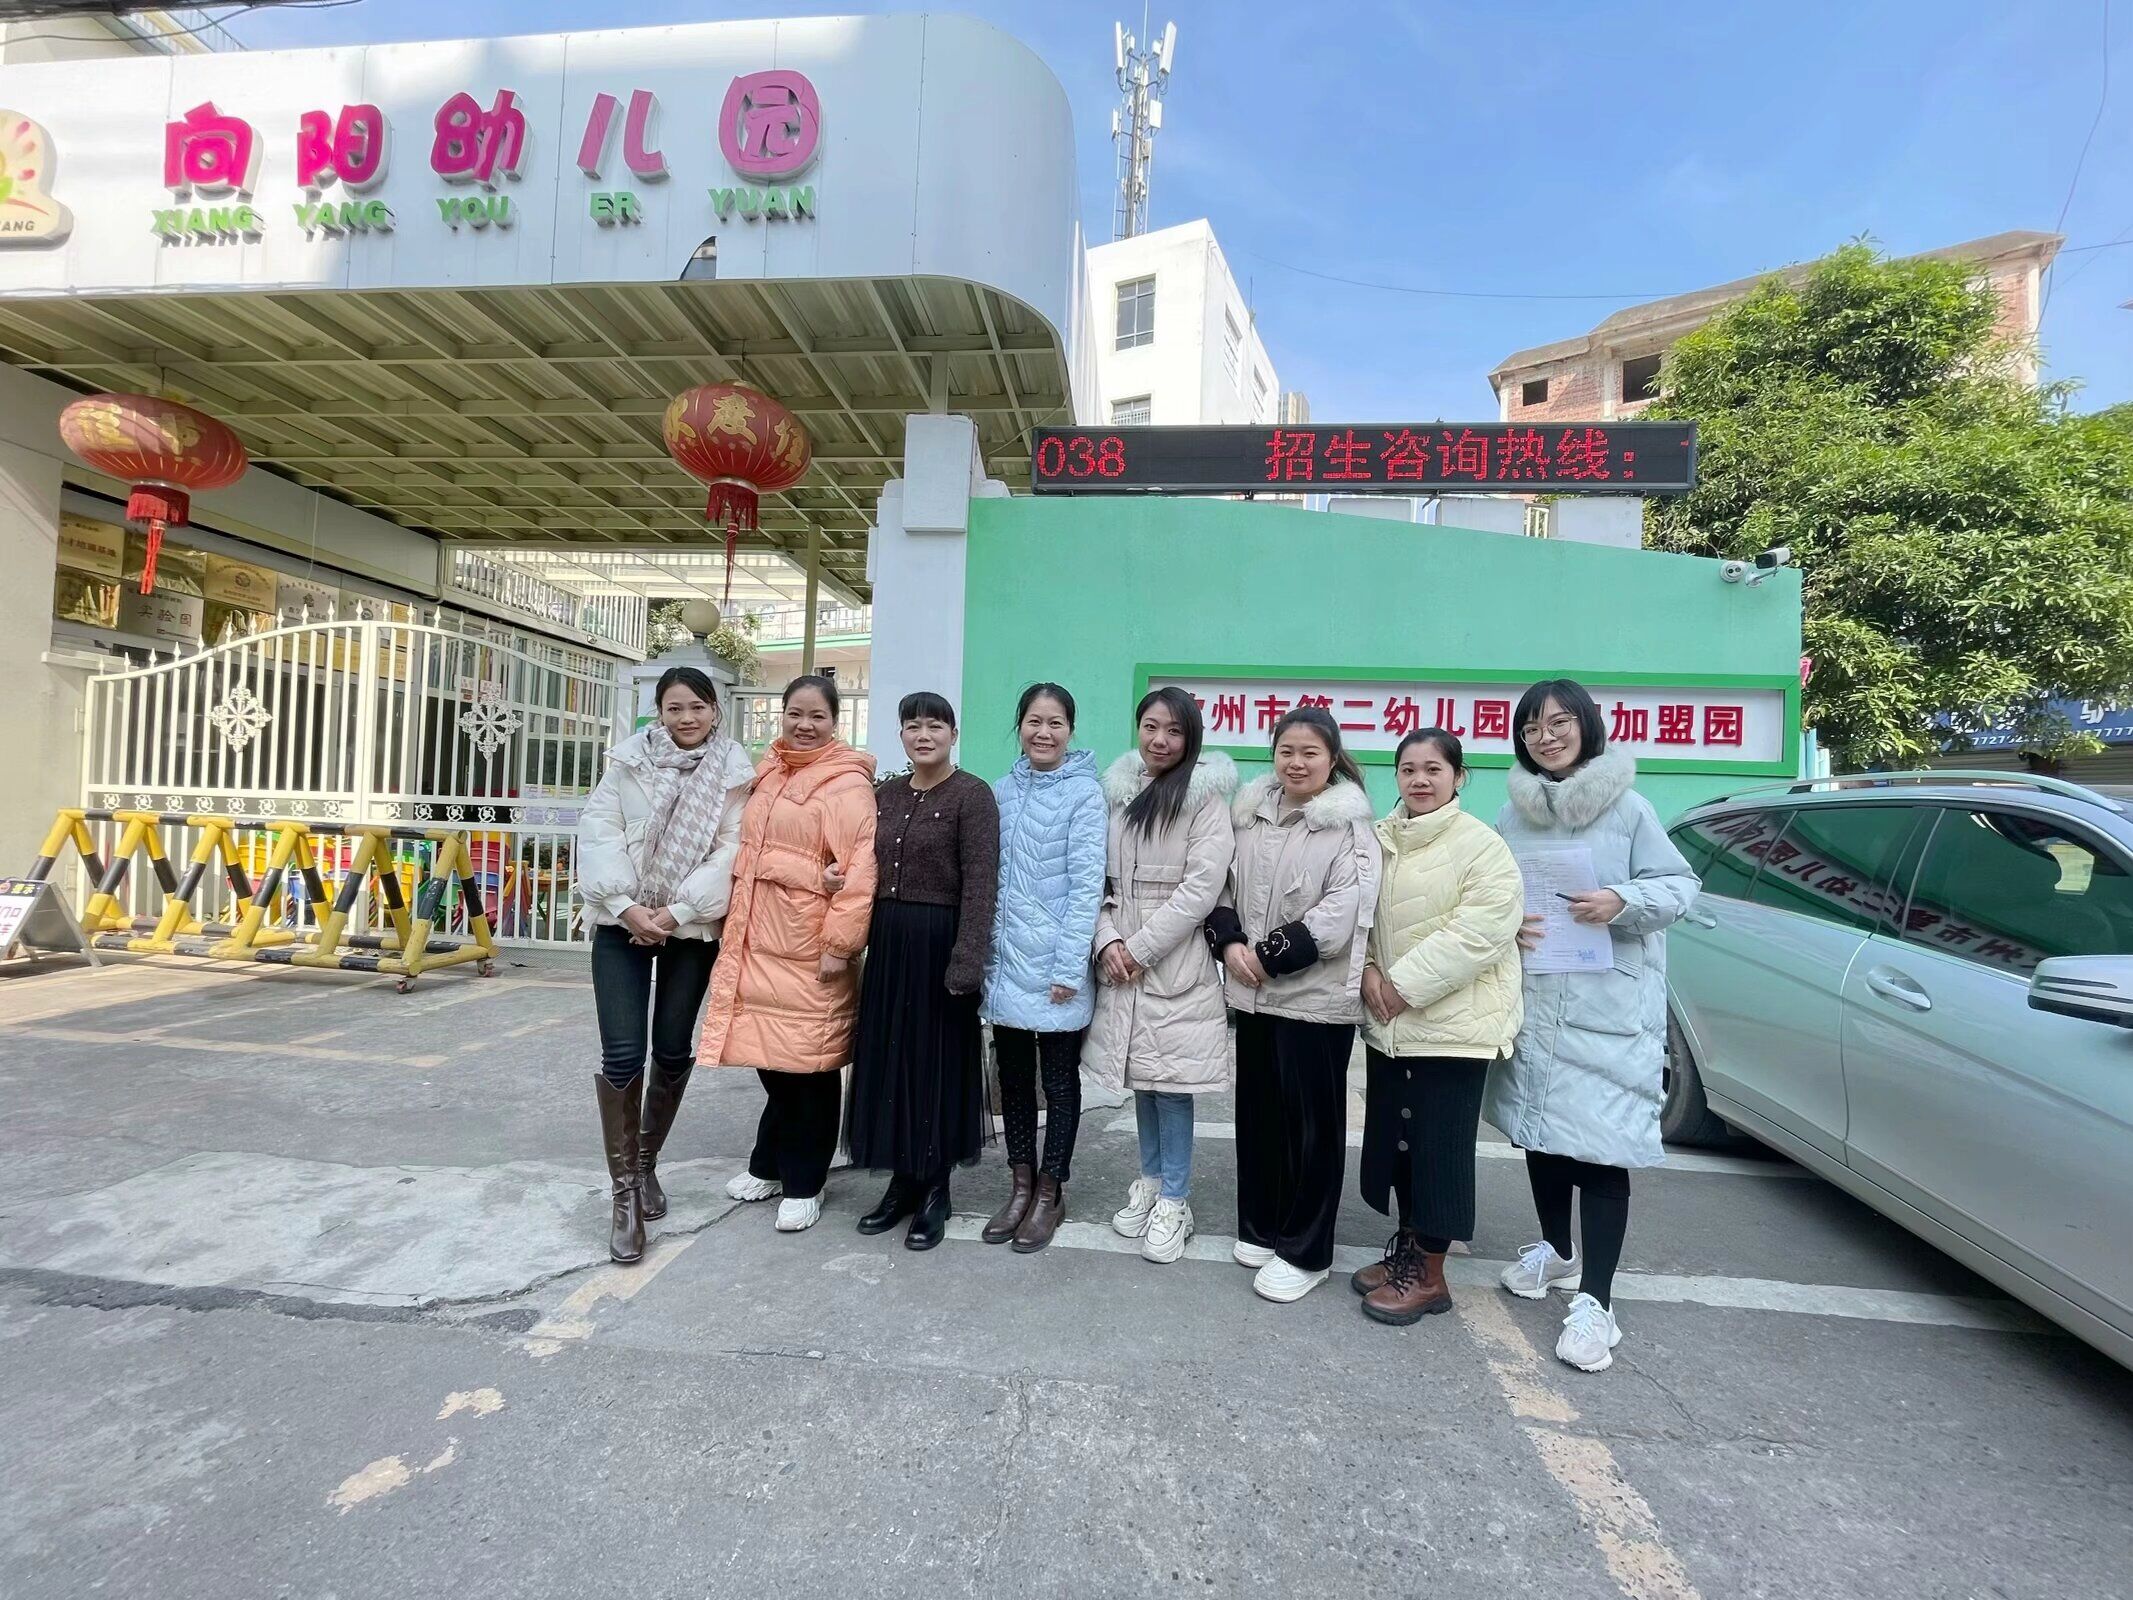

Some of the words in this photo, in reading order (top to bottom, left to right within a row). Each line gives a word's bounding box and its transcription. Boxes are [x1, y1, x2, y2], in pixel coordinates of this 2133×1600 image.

[164, 69, 822, 191] 向阳幼儿园
[0, 219, 36, 232] ANG
[151, 204, 260, 238] XIANG
[293, 200, 393, 234] YANG
[436, 195, 511, 227] YOU
[590, 191, 643, 223] ER
[708, 185, 816, 219] YUAN
[1037, 435, 1128, 477] 038
